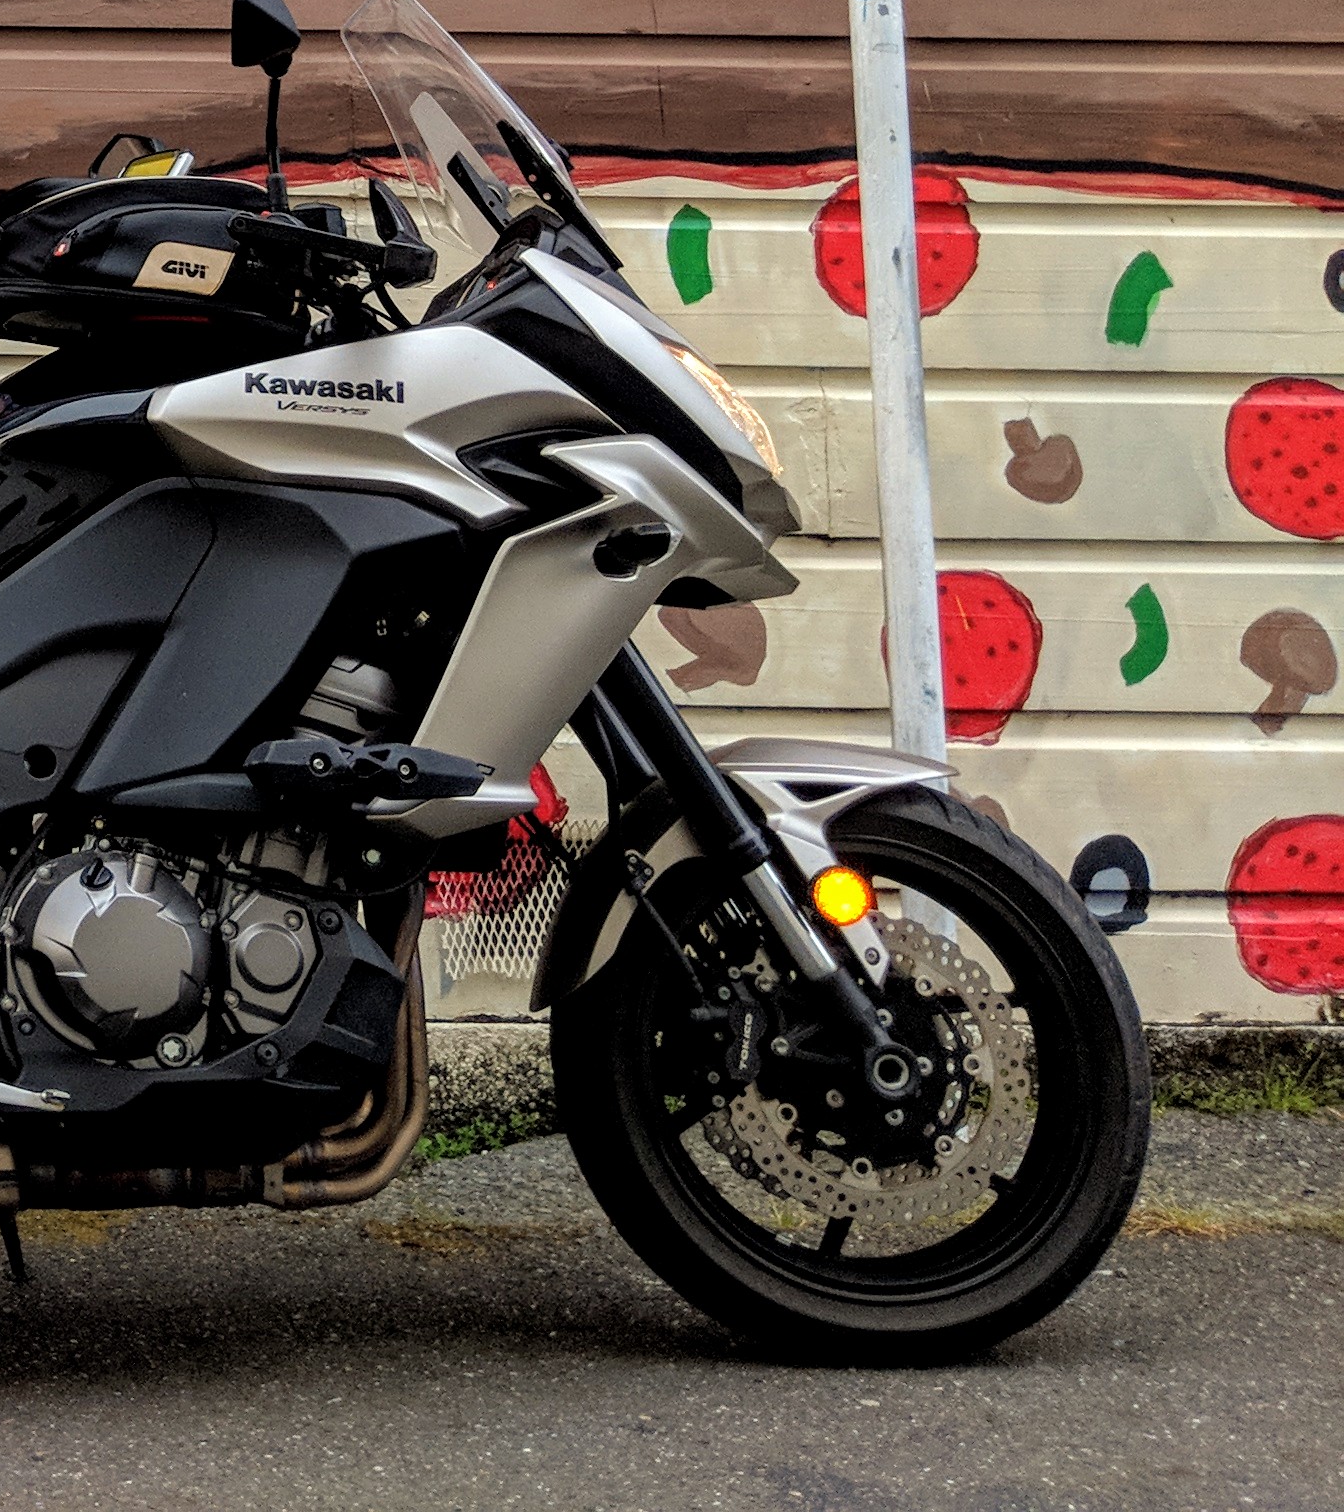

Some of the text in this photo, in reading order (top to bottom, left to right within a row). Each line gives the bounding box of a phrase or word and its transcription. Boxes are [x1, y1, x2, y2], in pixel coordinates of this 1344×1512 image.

[160, 260, 206, 279] GIVI
[244, 372, 405, 404] Kawasaki
[277, 400, 371, 416] VERSYS
